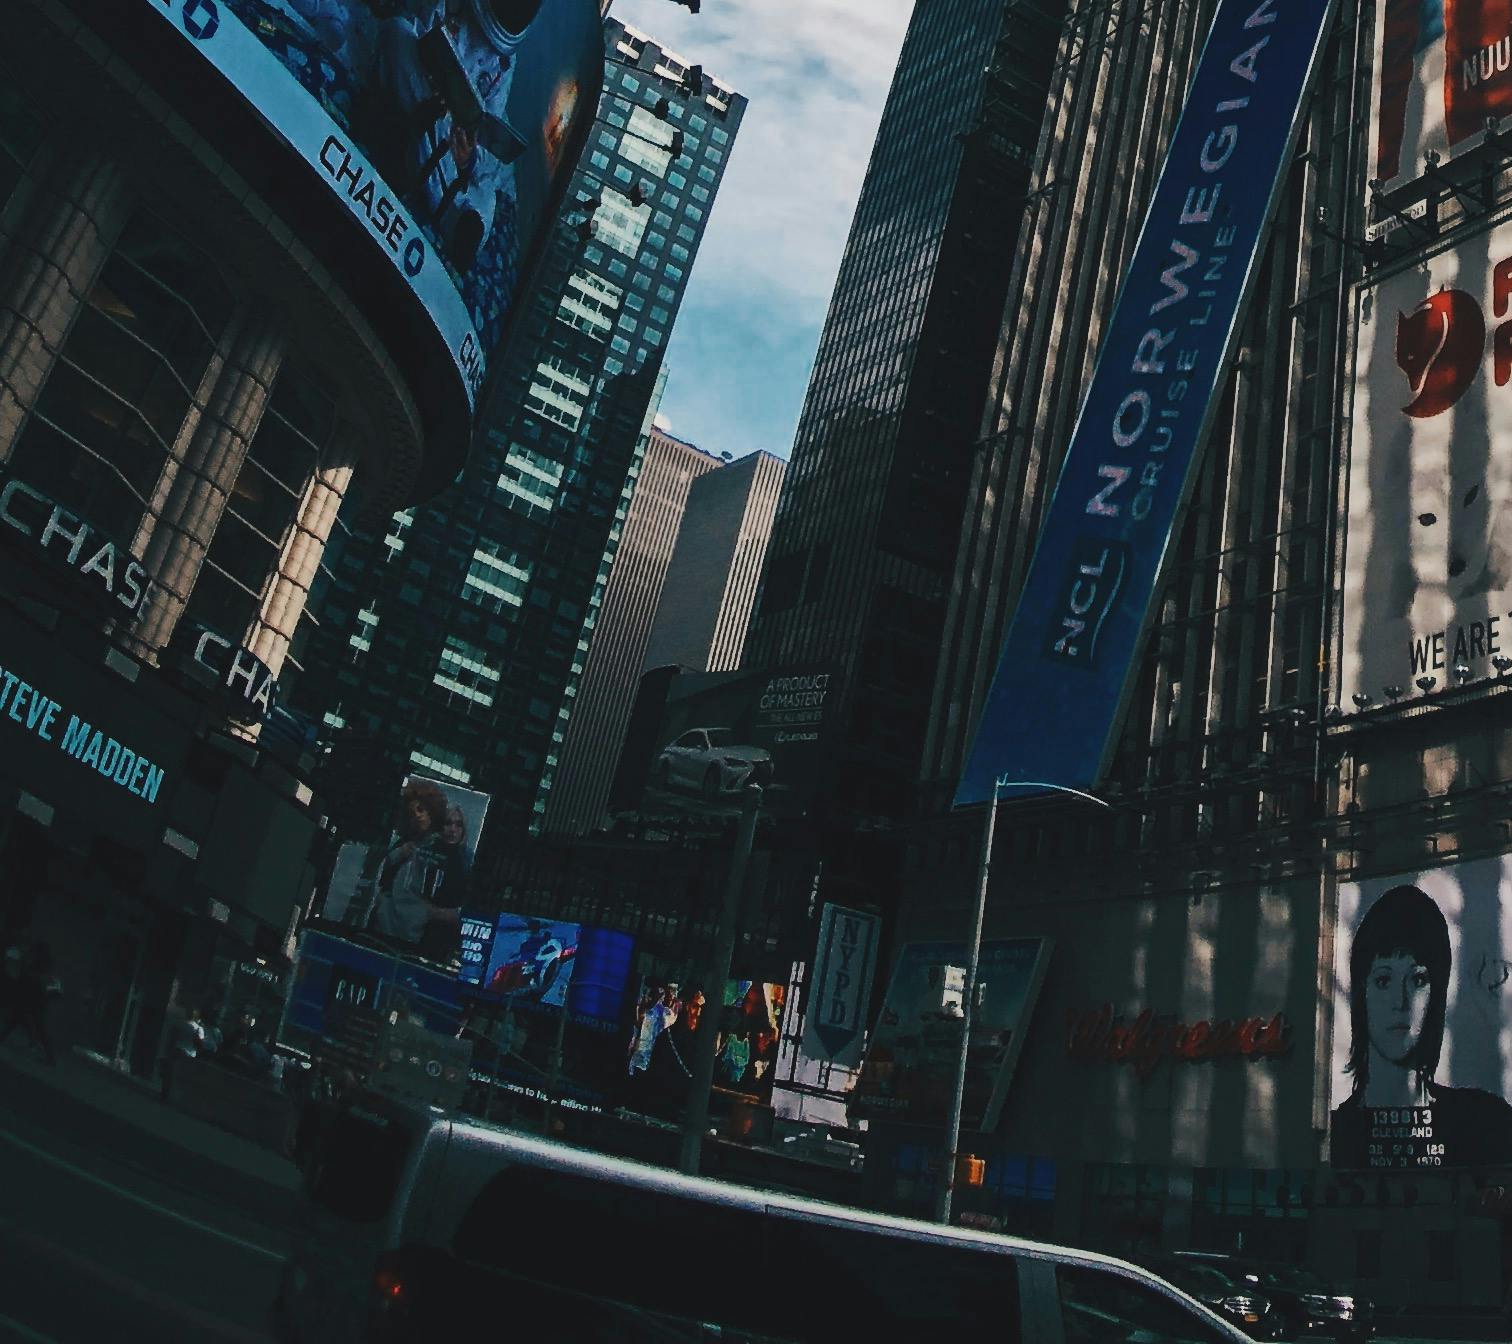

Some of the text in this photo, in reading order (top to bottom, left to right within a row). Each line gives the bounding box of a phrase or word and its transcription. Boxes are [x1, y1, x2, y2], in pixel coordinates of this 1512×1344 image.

[319, 135, 408, 254] CHASE
[1131, 222, 1237, 523] CRUISE LINE
[1053, 549, 1109, 659] NCL
[1409, 632, 1445, 676] WE
[1454, 616, 1501, 663] ARE
[194, 628, 278, 719] CHA
[776, 674, 831, 691] PRODUCT
[777, 691, 826, 708] MASTERY
[0, 666, 165, 805] TEVE MADDEN
[829, 916, 860, 1025] NYPD
[1372, 1127, 1432, 1138] CLEVELAND
